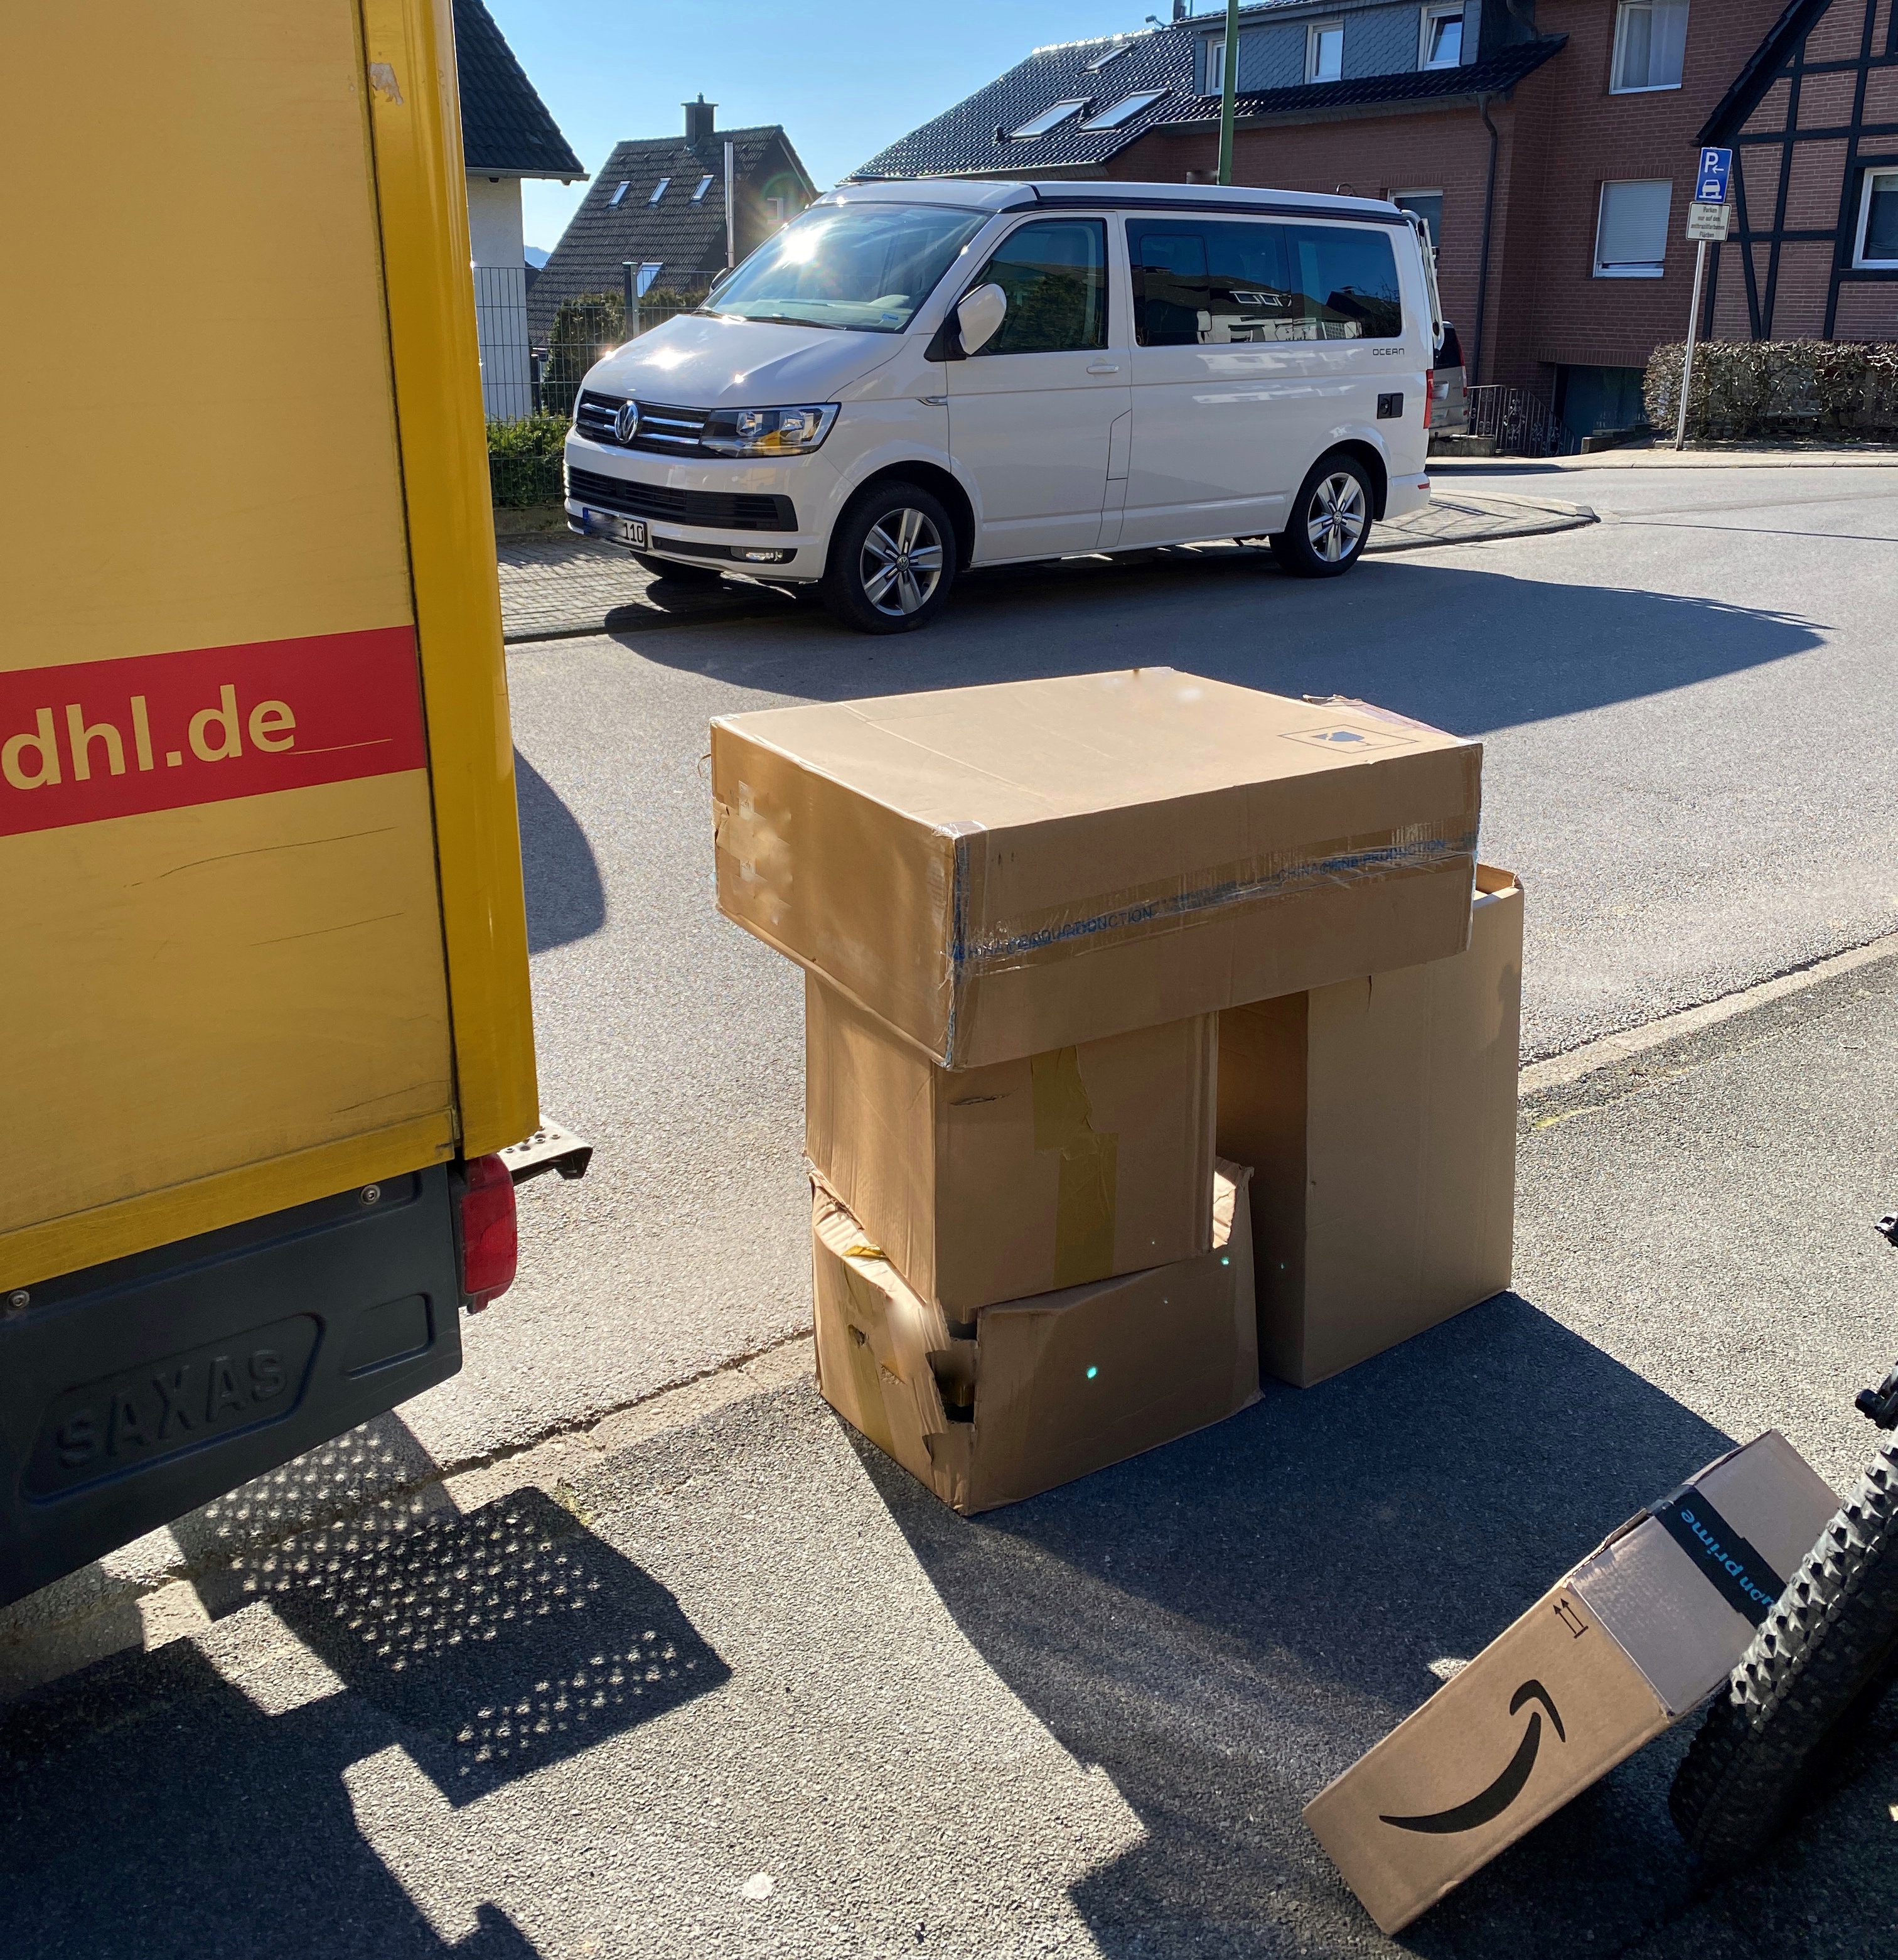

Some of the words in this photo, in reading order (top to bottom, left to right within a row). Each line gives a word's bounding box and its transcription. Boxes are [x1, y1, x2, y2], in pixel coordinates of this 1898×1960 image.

[1704, 151, 1719, 173] P
[1372, 348, 1405, 356] OCEAN
[1, 684, 296, 790] dhl.de
[54, 1349, 289, 1470] SAXAS
[1680, 1509, 1744, 1577] prime
